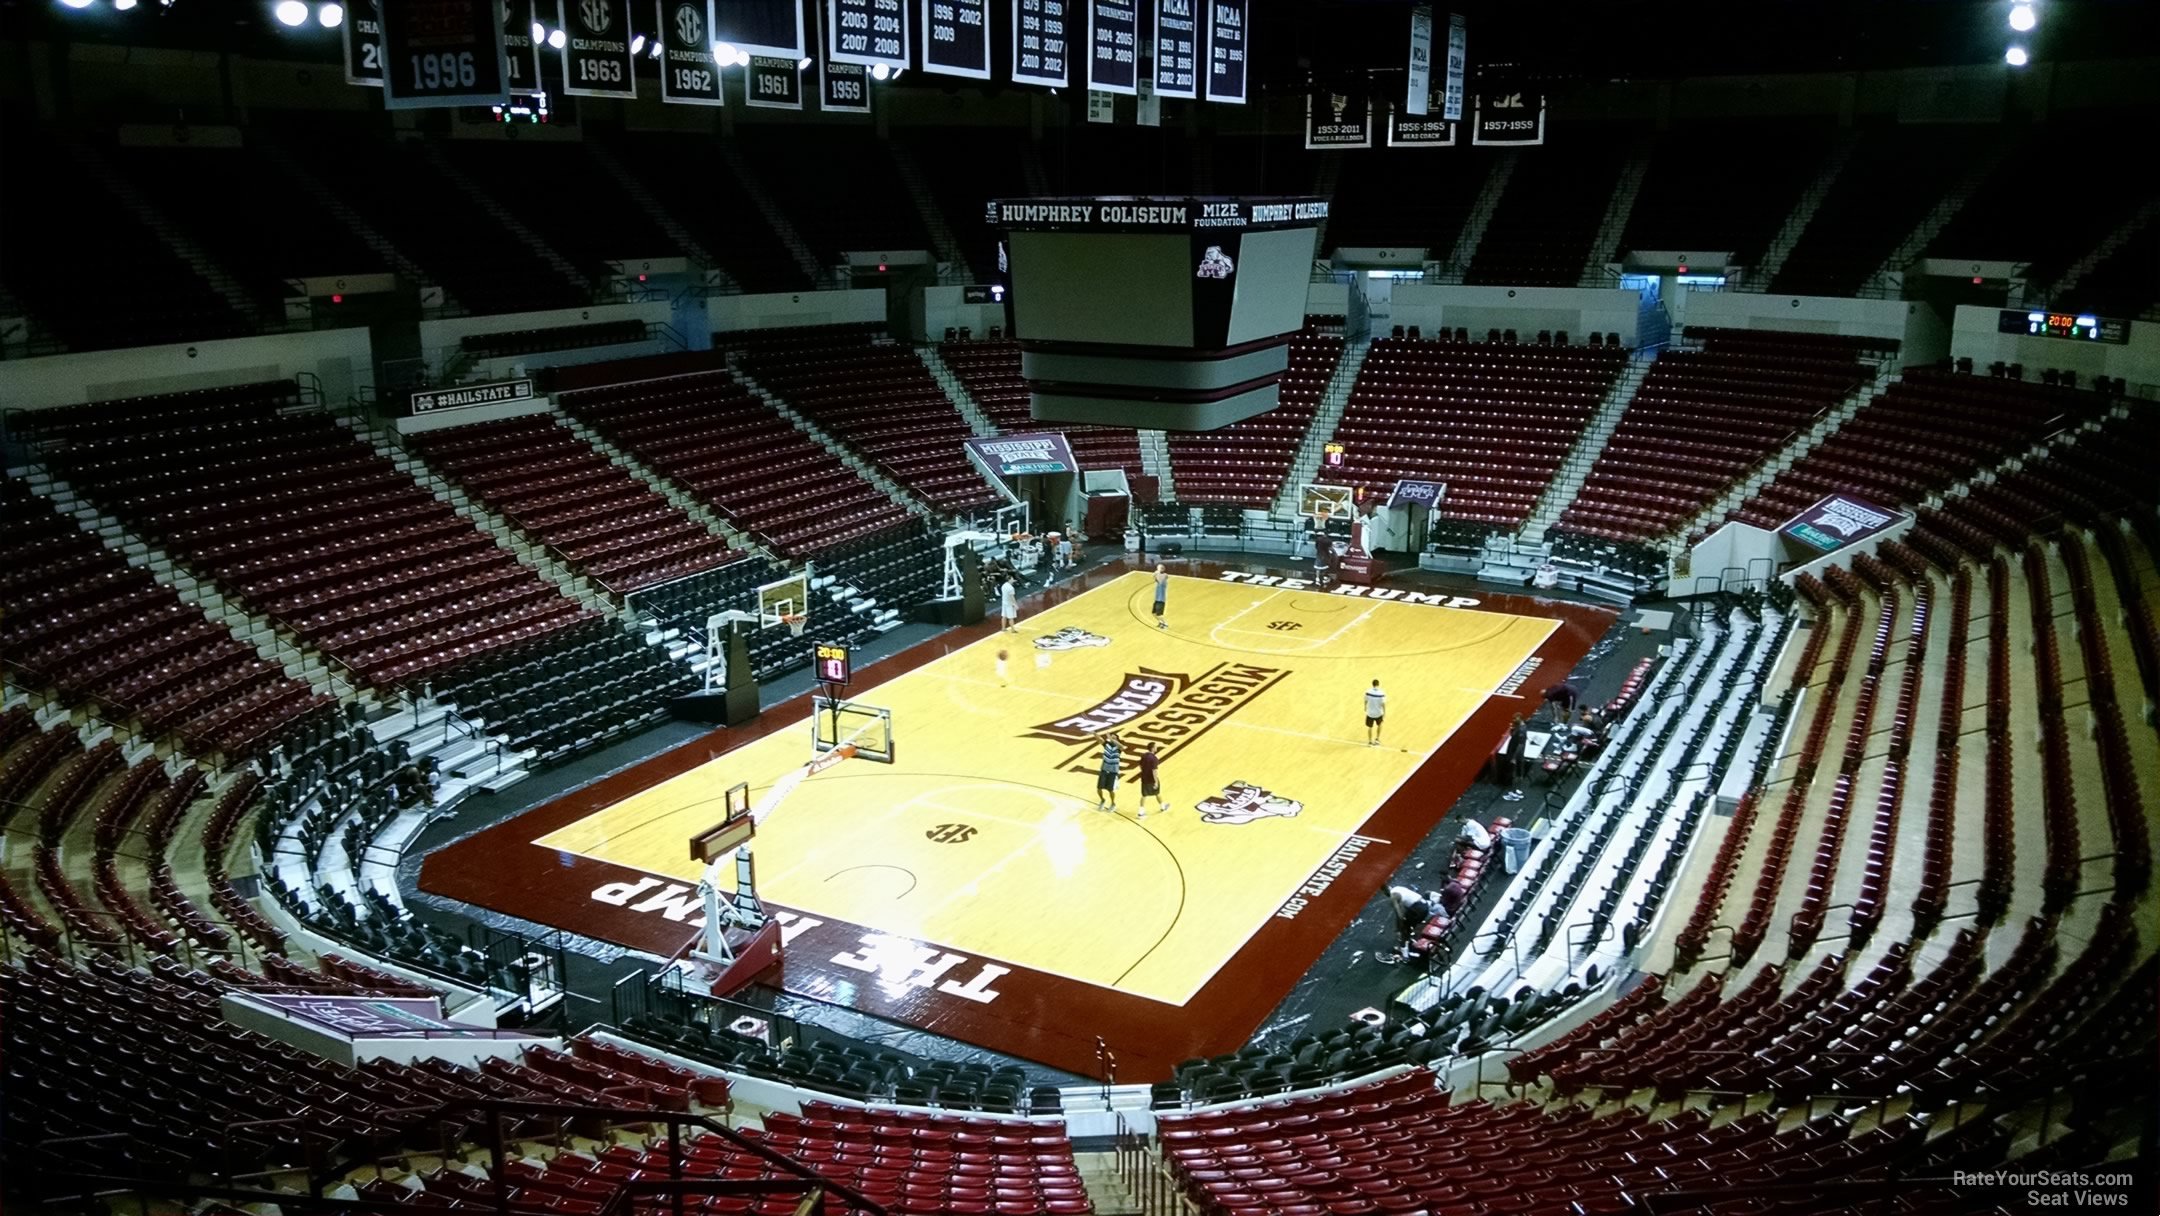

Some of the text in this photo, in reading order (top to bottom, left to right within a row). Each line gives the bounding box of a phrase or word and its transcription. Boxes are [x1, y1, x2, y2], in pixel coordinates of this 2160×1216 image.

[933, 3, 981, 26] 1996 2002
[1163, 0, 1190, 17] NCAA
[1216, 4, 1241, 27] NCAA
[676, 6, 701, 45] SEC
[841, 11, 900, 33] 2003 2004
[933, 25, 955, 42] 2009
[572, 40, 626, 54] CHAMPIONS
[841, 34, 900, 55] 2007 2008
[411, 51, 475, 90] 1996
[579, 59, 622, 82] 1963
[754, 57, 794, 70] CHAMPIONS
[675, 69, 712, 91] 1962
[758, 74, 789, 95] 1961
[832, 80, 861, 101] 1959
[1317, 125, 1360, 135] 1953-2011
[1484, 120, 1534, 131] 1957-1959
[1002, 205, 1094, 222] HUMPHREY
[1100, 206, 1187, 225] COLISEUM
[1203, 203, 1240, 218] MIZE
[1252, 202, 1329, 223] HUMPHREY COLISEUM
[1194, 217, 1248, 228] FOUNDATION
[437, 386, 512, 407] #HAILSTATE
[1220, 570, 1481, 609] THE HUMP
[1266, 620, 1304, 632] SEC
[817, 645, 845, 662] 20:00
[1054, 679, 1166, 733] STATE
[925, 823, 978, 844] SEC
[1275, 837, 1371, 920] HAILSTATE.COM
[829, 933, 1011, 1004] THE
